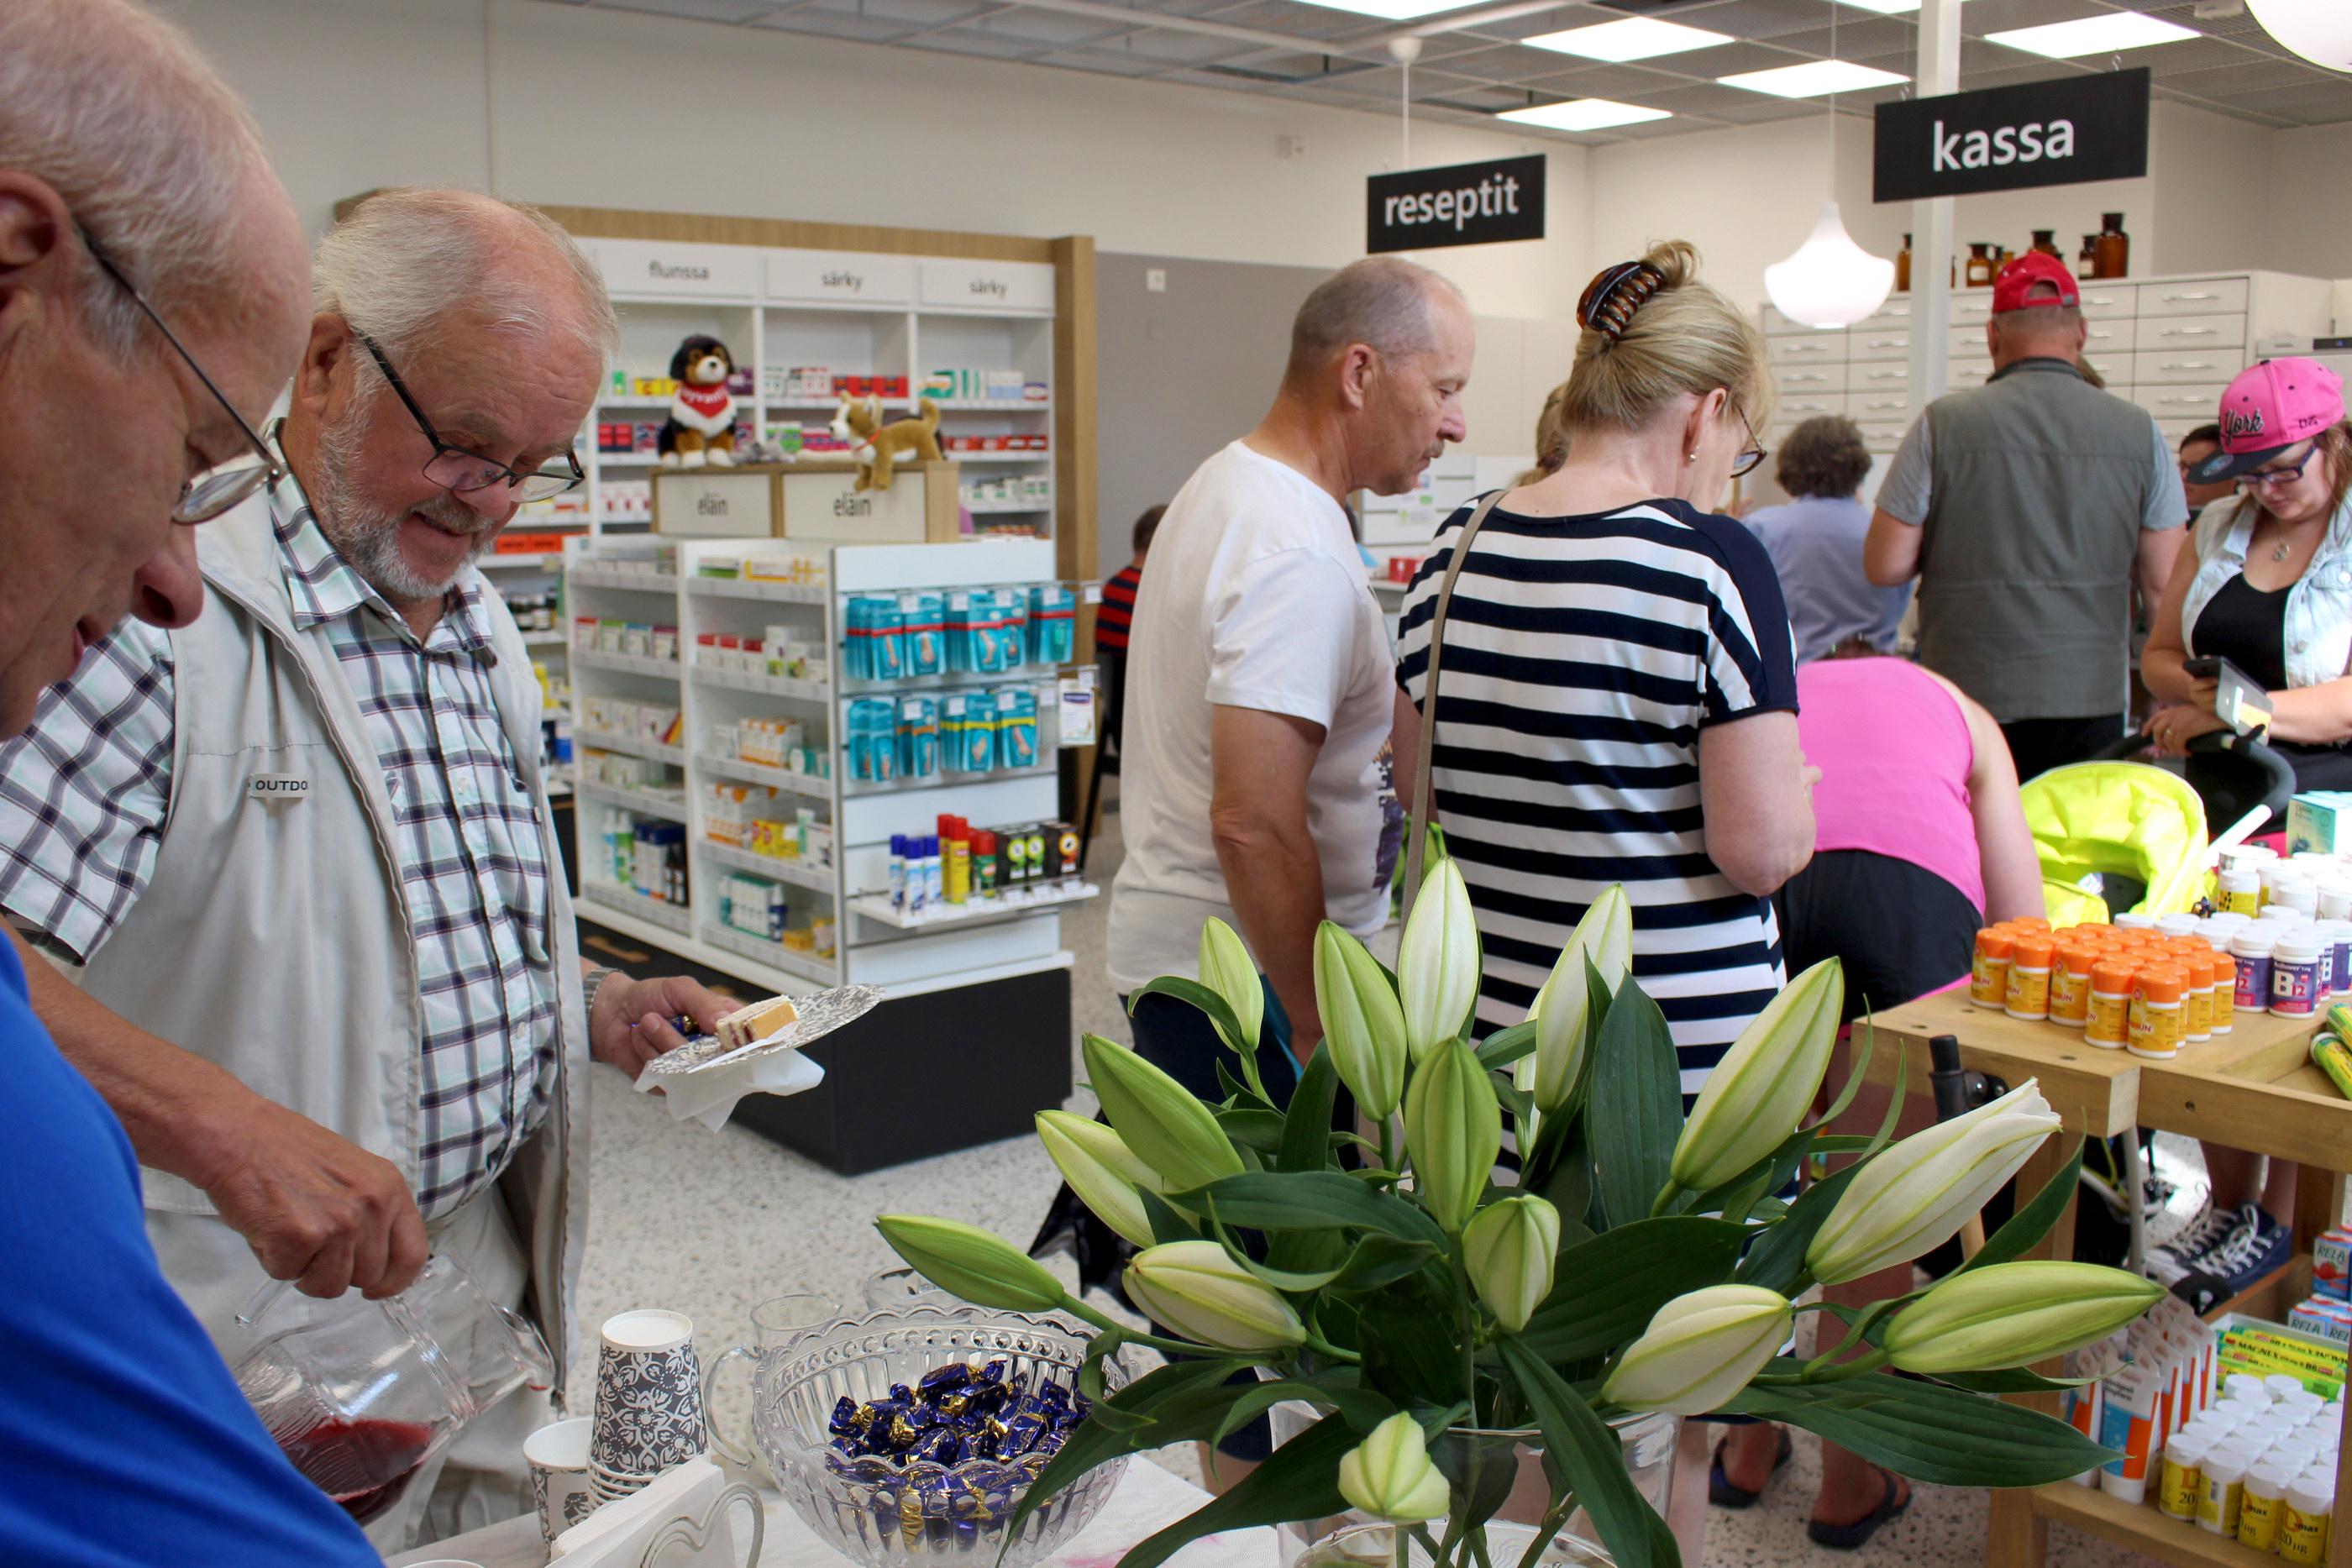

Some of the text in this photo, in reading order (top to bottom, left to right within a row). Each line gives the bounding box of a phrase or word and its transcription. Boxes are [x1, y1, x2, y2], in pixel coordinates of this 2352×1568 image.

[1933, 118, 2076, 173] kassa
[1384, 173, 1520, 231] reseptit
[649, 261, 711, 281] flunssa
[821, 271, 864, 291] särky
[969, 280, 1006, 298] särky
[2226, 408, 2264, 446] York
[697, 492, 728, 516] eläin
[833, 491, 871, 517] eläin
[2317, 1245, 2345, 1263] RELA
[2291, 1318, 2321, 1335] RELA
[2329, 1327, 2349, 1341] REL
[2238, 1341, 2278, 1360] MAGNEX
[2306, 1362, 2318, 1371] B6
[2179, 1492, 2196, 1505] 20
